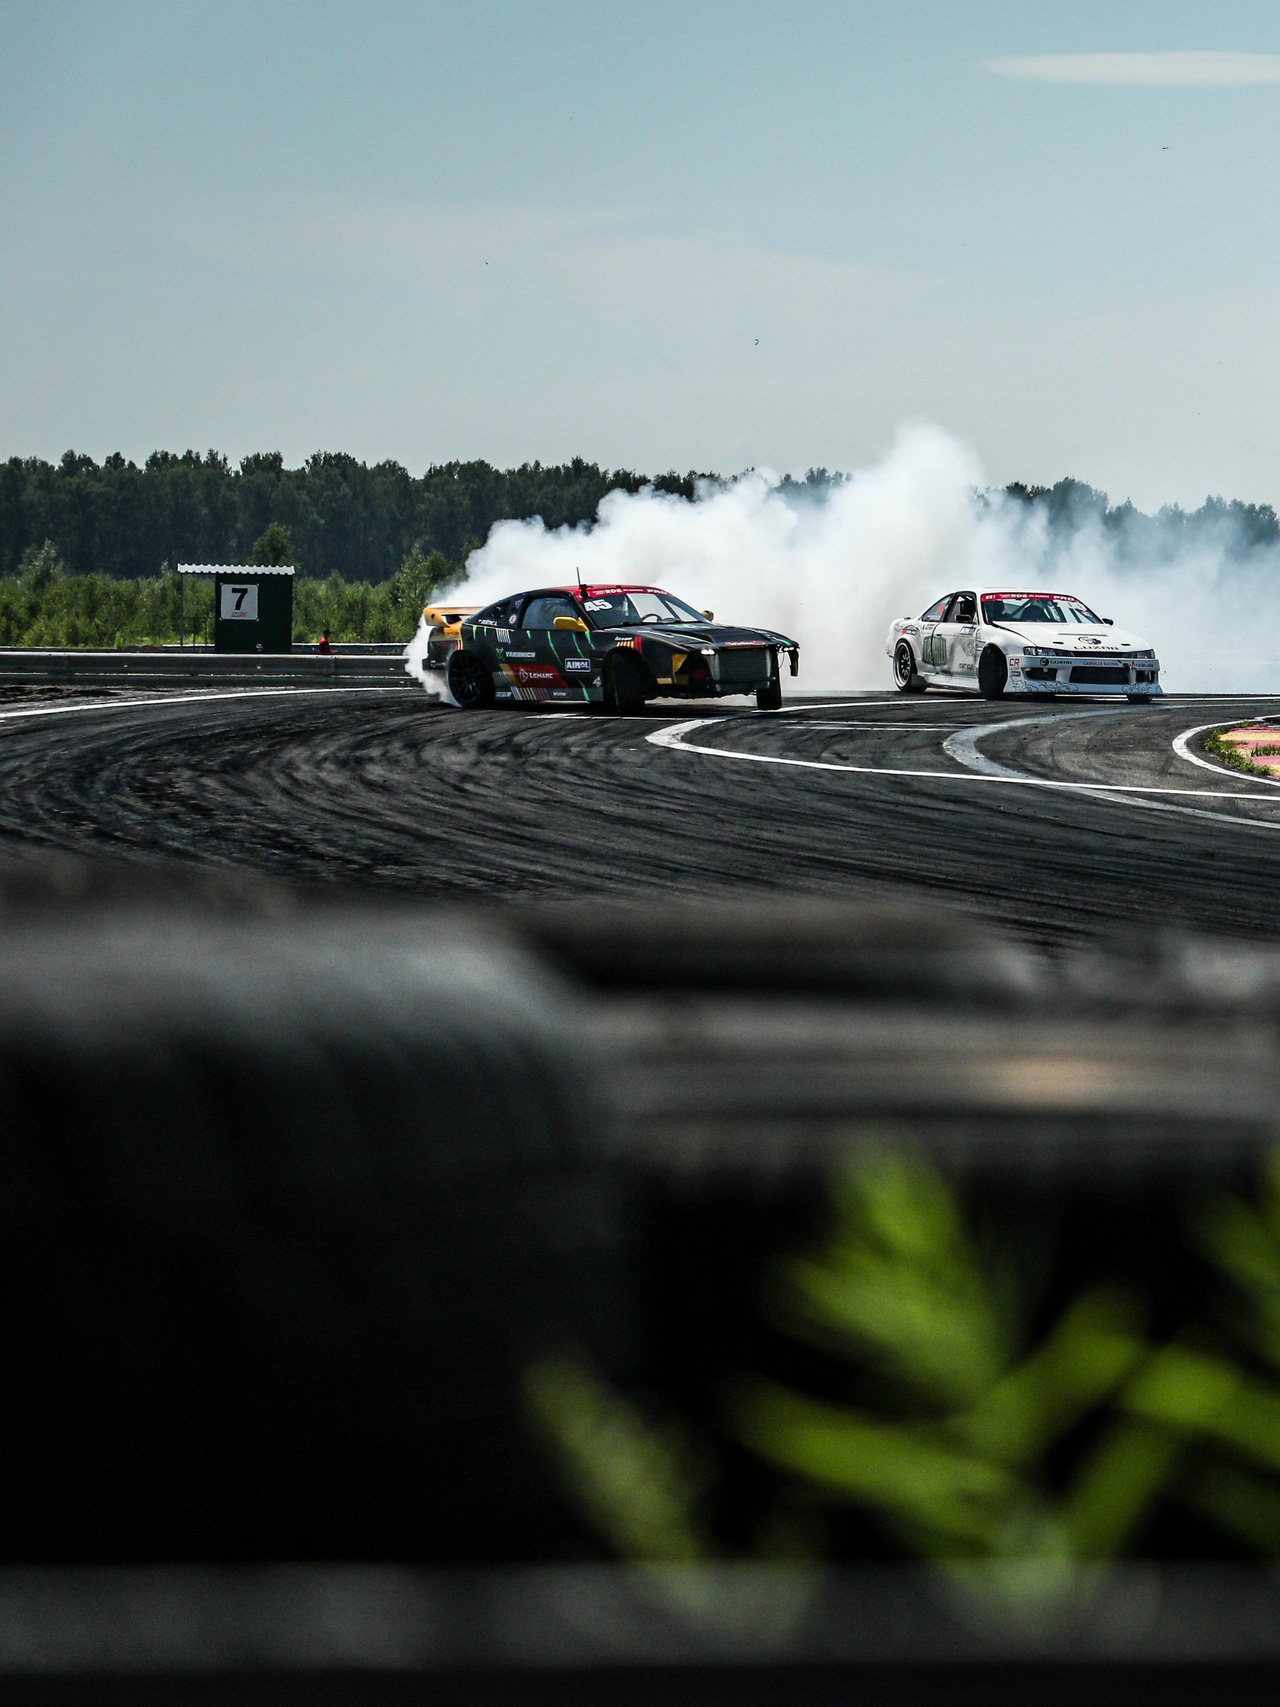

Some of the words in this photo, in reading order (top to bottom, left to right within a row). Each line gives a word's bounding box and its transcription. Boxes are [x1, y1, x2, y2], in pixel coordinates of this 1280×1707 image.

[231, 588, 248, 611] 7
[583, 599, 613, 612] 45
[1009, 658, 1020, 666] CR
